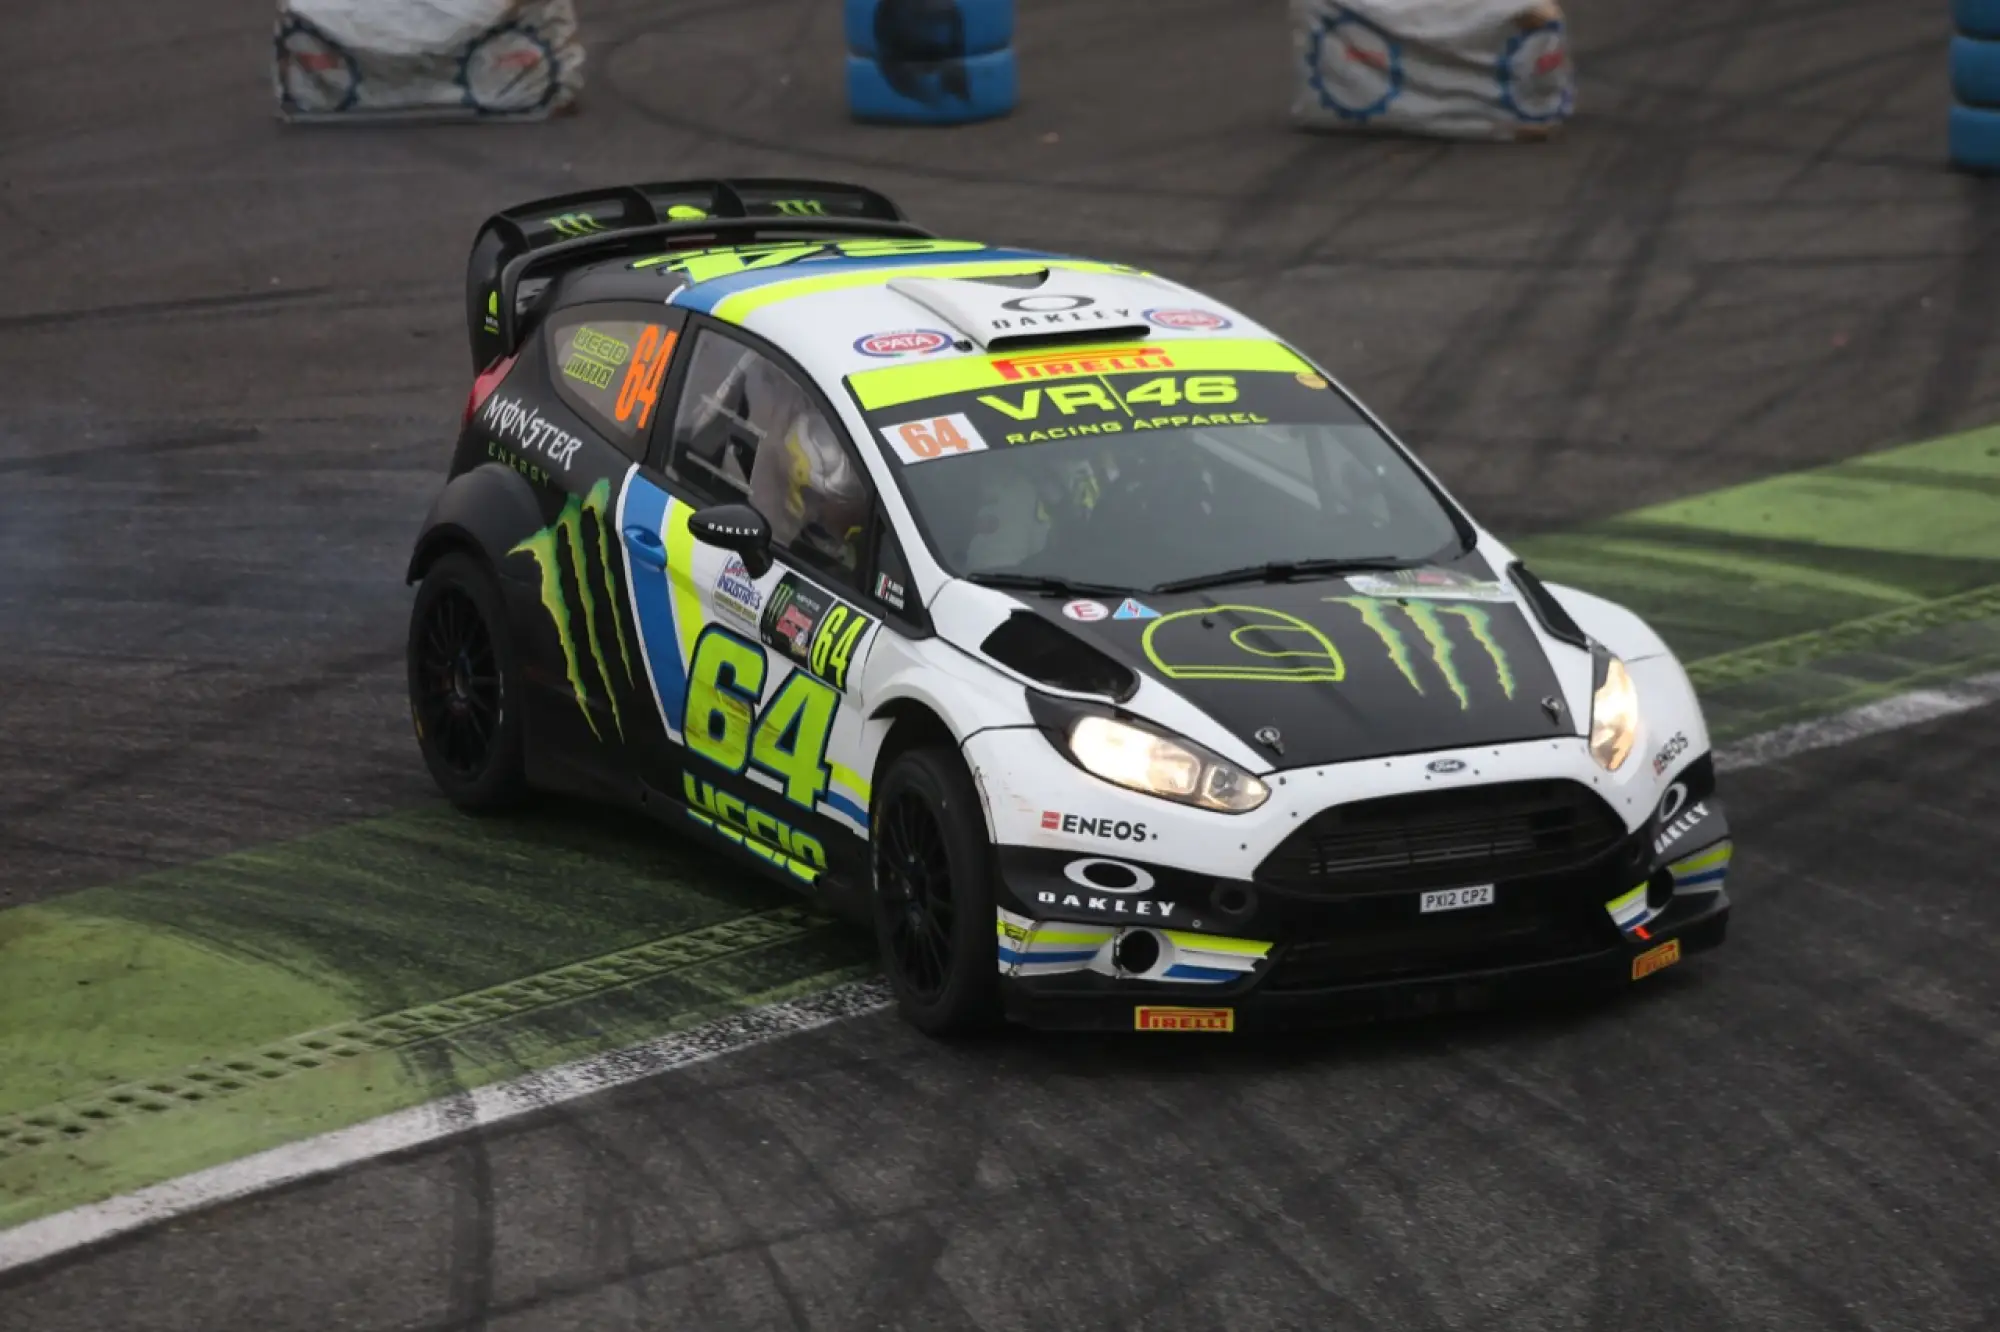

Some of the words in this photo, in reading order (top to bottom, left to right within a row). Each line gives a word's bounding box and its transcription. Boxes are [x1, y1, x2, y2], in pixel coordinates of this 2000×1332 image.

[991, 308, 1130, 330] OAKLEY
[872, 335, 933, 352] PATA
[615, 323, 678, 429] 64
[991, 347, 1175, 380] PIRELLI
[900, 417, 968, 457] 64
[1005, 421, 1123, 445] RACING
[1133, 412, 1268, 430] APPAREL
[487, 441, 549, 487] ENERGY
[707, 522, 760, 536] OAKLEY
[810, 604, 867, 688] 64
[684, 623, 841, 811] 64
[682, 769, 828, 884] UCCIO
[1061, 814, 1147, 842] ENEOS
[1654, 801, 1709, 854] OAKLEY
[1038, 891, 1175, 917] OAKLEY
[1426, 892, 1457, 909] PX12
[1461, 888, 1489, 905] CPZ
[1140, 1008, 1228, 1029] PIRELLI
